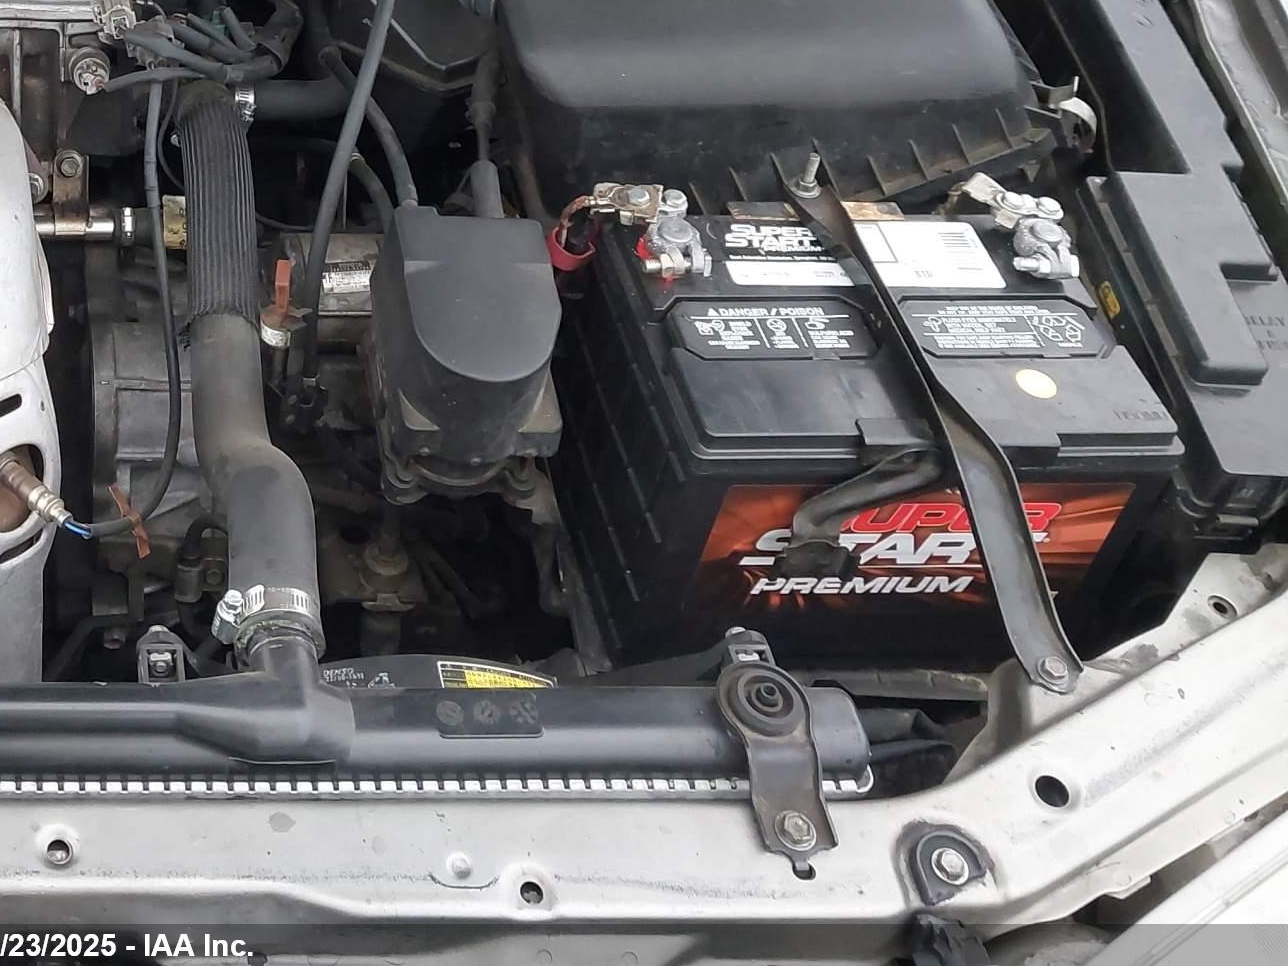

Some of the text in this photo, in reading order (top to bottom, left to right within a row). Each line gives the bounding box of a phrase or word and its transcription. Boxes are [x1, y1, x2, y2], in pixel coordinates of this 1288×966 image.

[730, 223, 814, 237] SUPER
[724, 233, 817, 248] START
[718, 308, 769, 317] DANGER
[779, 307, 825, 316] POISON
[750, 576, 975, 595] PREMIUM
